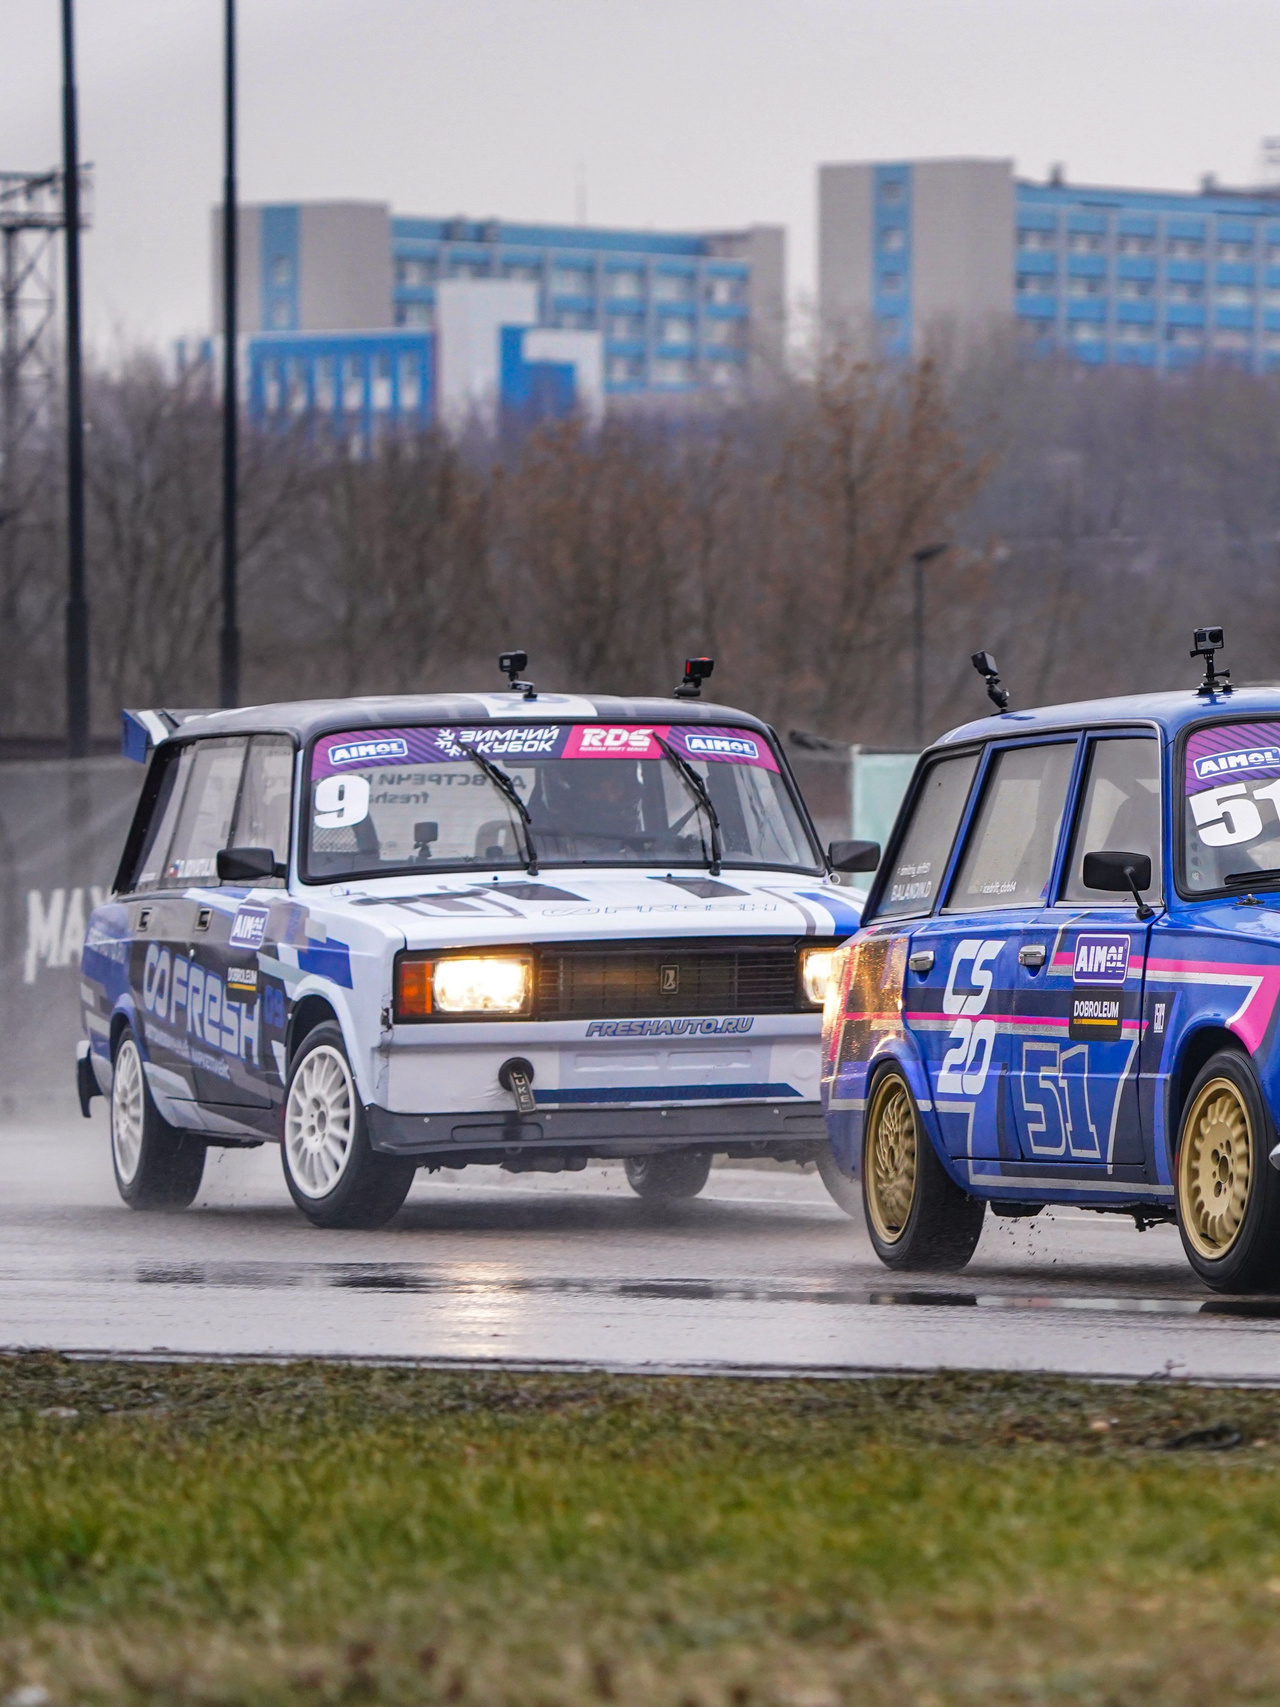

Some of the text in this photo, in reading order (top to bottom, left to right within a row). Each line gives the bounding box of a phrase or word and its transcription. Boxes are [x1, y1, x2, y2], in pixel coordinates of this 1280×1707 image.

[459, 725, 560, 742] ЗИМНИЙ
[582, 728, 654, 746] RDS
[333, 741, 403, 761] AIMOL
[477, 740, 556, 754] КУБОК
[690, 738, 755, 754] AIMOL
[1200, 751, 1280, 775] AIMOL
[314, 775, 370, 828] 9
[1075, 946, 1125, 972] AIMOL
[943, 939, 1006, 1015] CS
[1074, 1001, 1119, 1017] DOBROLEUM
[585, 1017, 754, 1037] FRESHAUTO.RU
[937, 1019, 996, 1095] 20
[1021, 1042, 1101, 1158] 51
